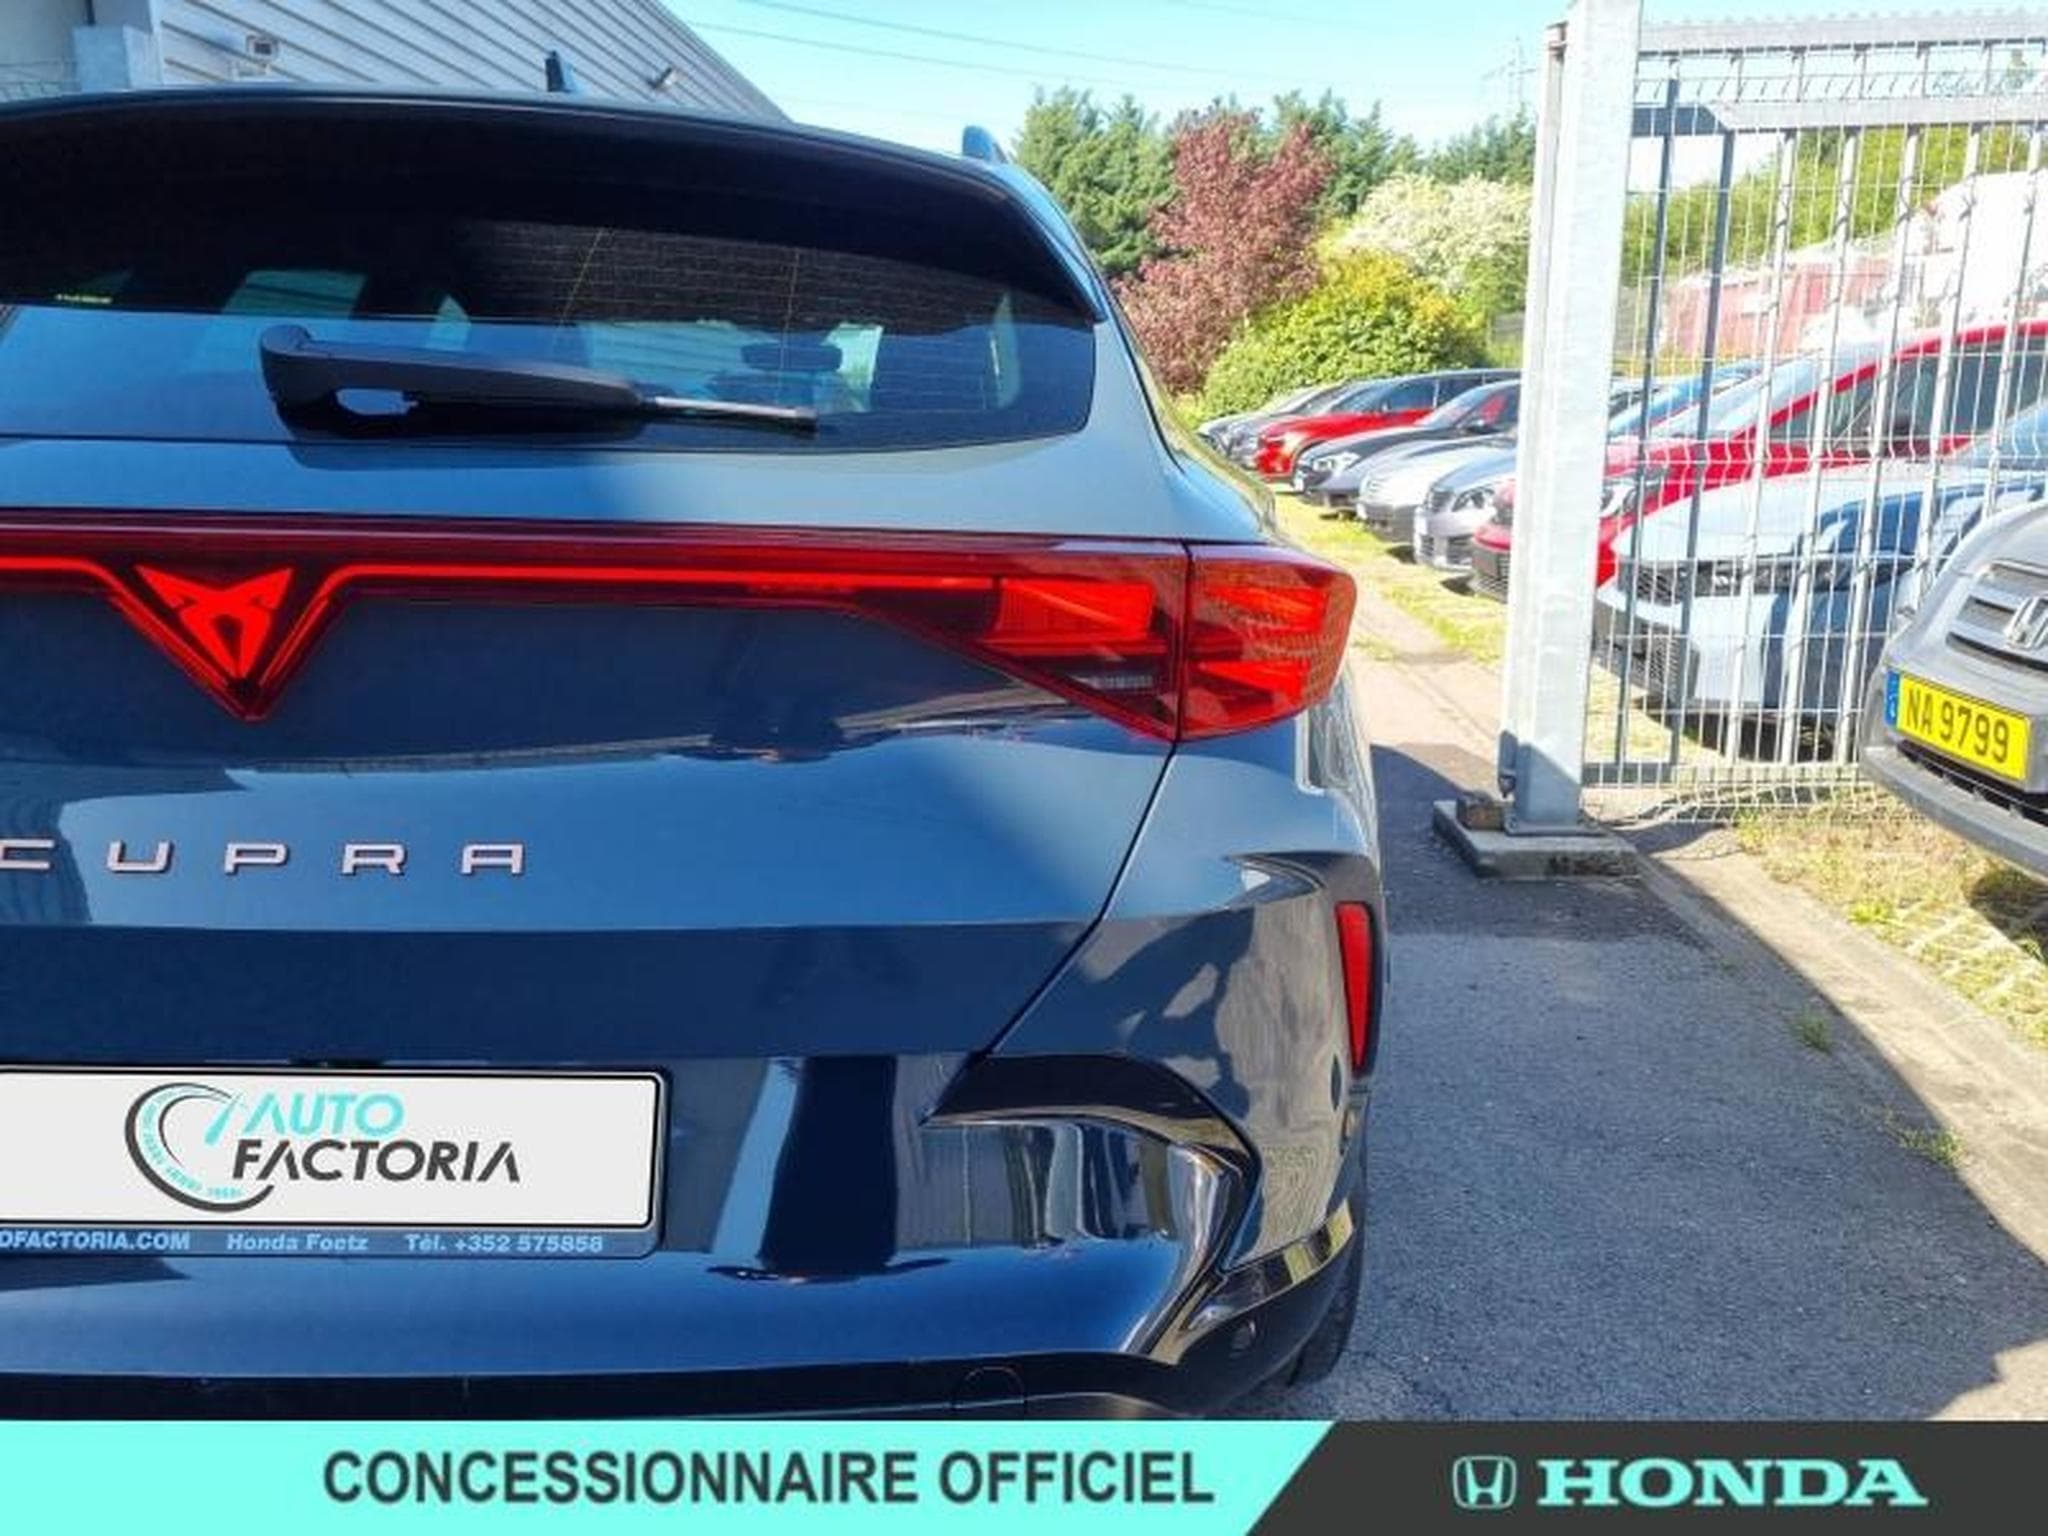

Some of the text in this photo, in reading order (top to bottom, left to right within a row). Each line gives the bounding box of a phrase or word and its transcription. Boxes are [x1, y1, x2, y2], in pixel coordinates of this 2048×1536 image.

[1906, 687, 2010, 764] NA 9799
[0, 839, 524, 875] CUPRA
[243, 1090, 405, 1136] AUTO
[232, 1138, 520, 1183] FACTORIA
[226, 1233, 299, 1251] Honda
[455, 1234, 511, 1251] +352
